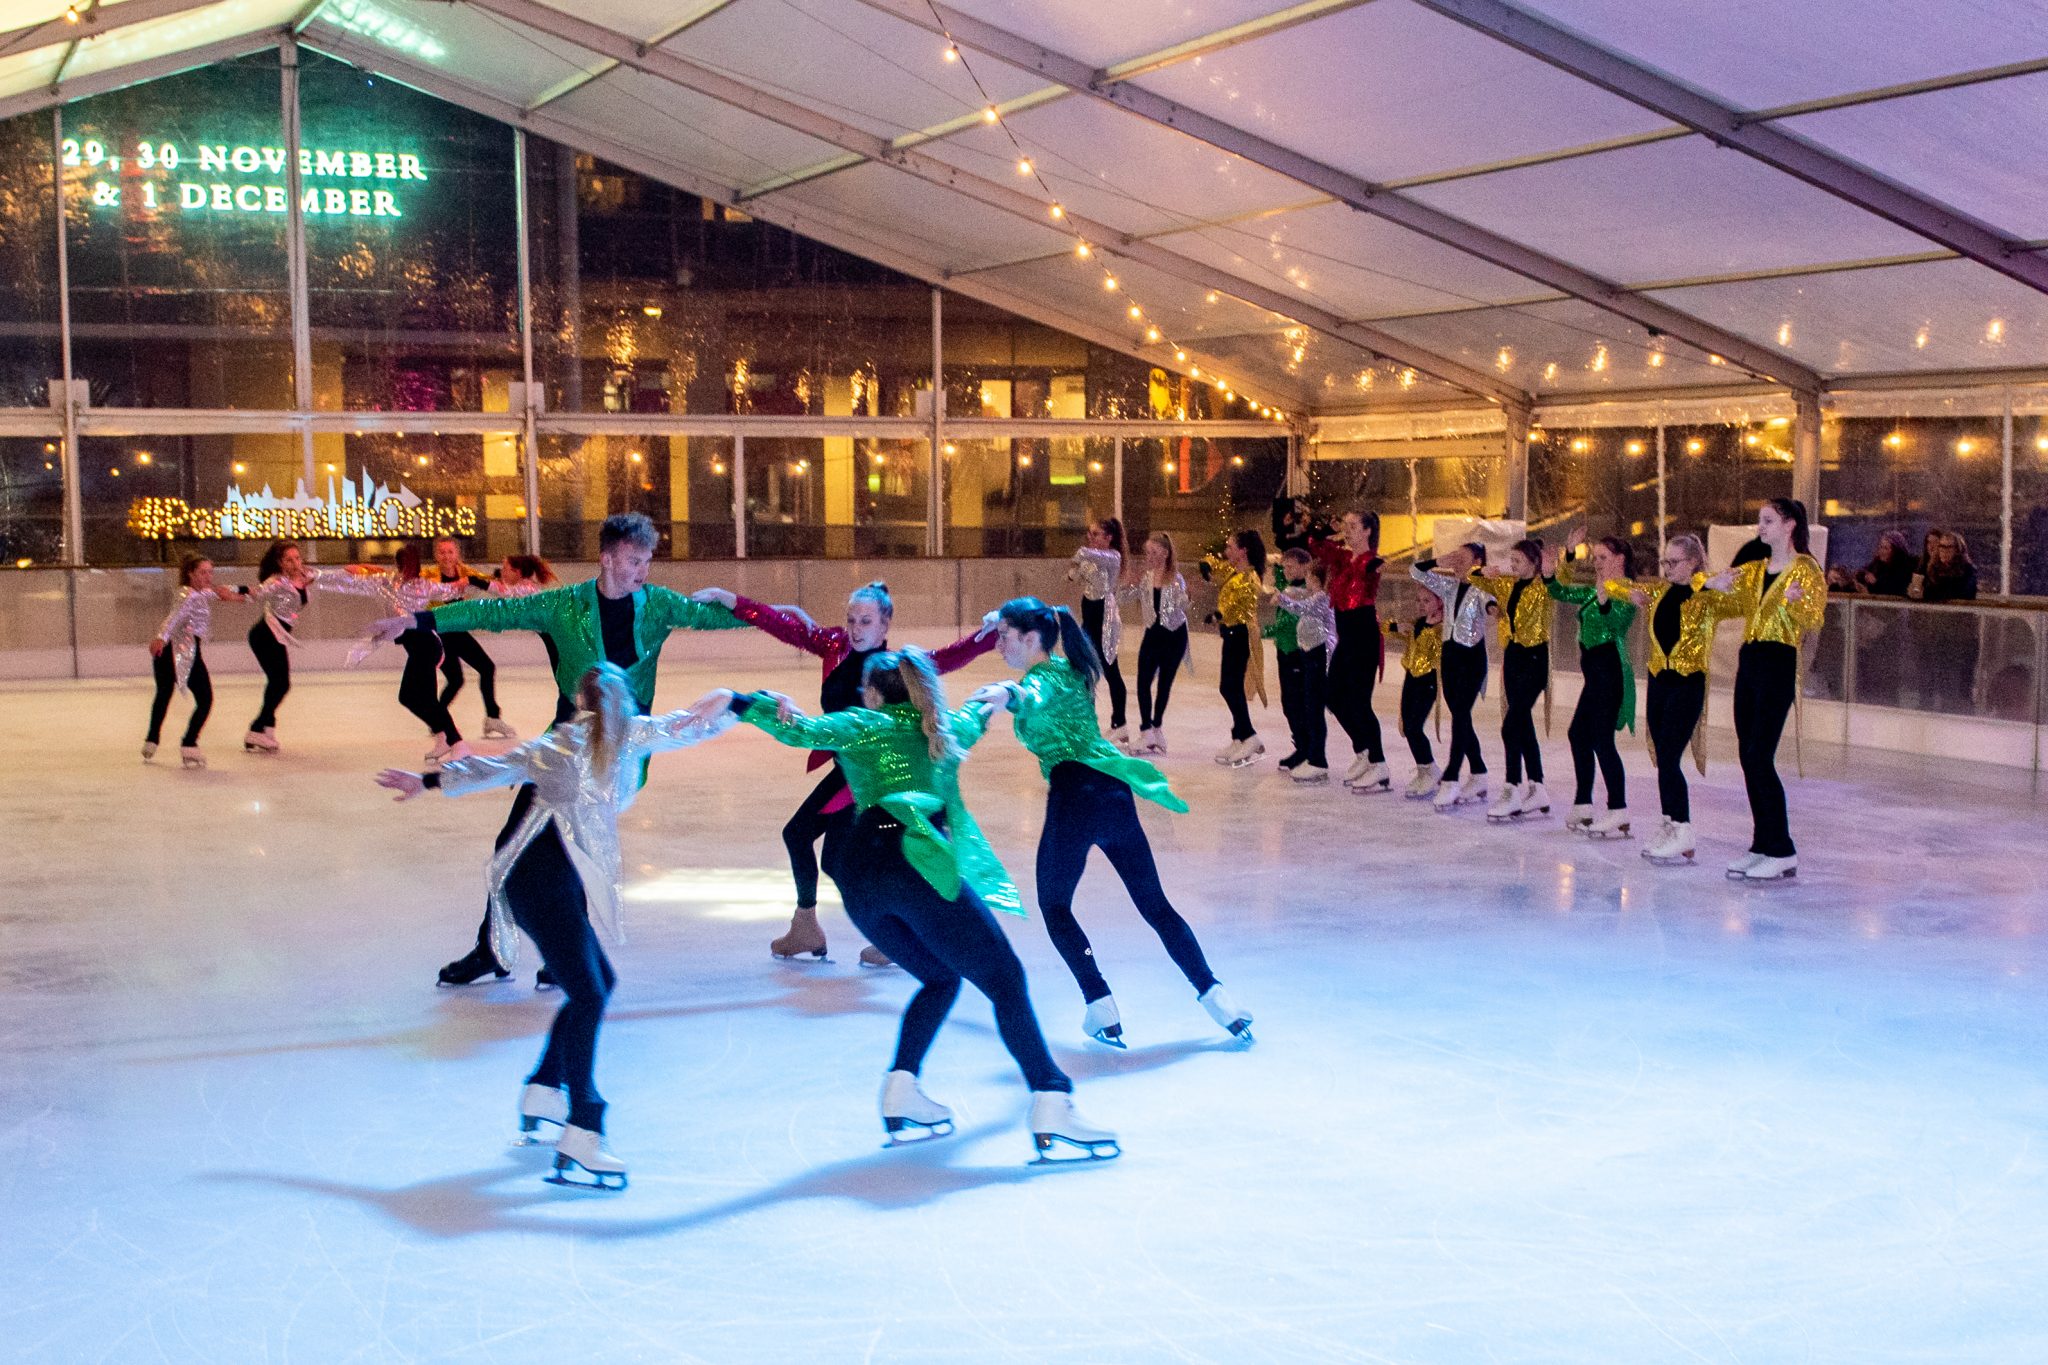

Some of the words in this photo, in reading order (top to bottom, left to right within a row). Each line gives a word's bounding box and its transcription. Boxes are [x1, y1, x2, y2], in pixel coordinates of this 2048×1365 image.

[61, 139, 120, 171] 29,
[137, 142, 179, 170] 30
[199, 145, 428, 181] NOVEMBER
[93, 181, 121, 206] &
[143, 182, 157, 208] 1
[180, 183, 402, 217] DECEMBER
